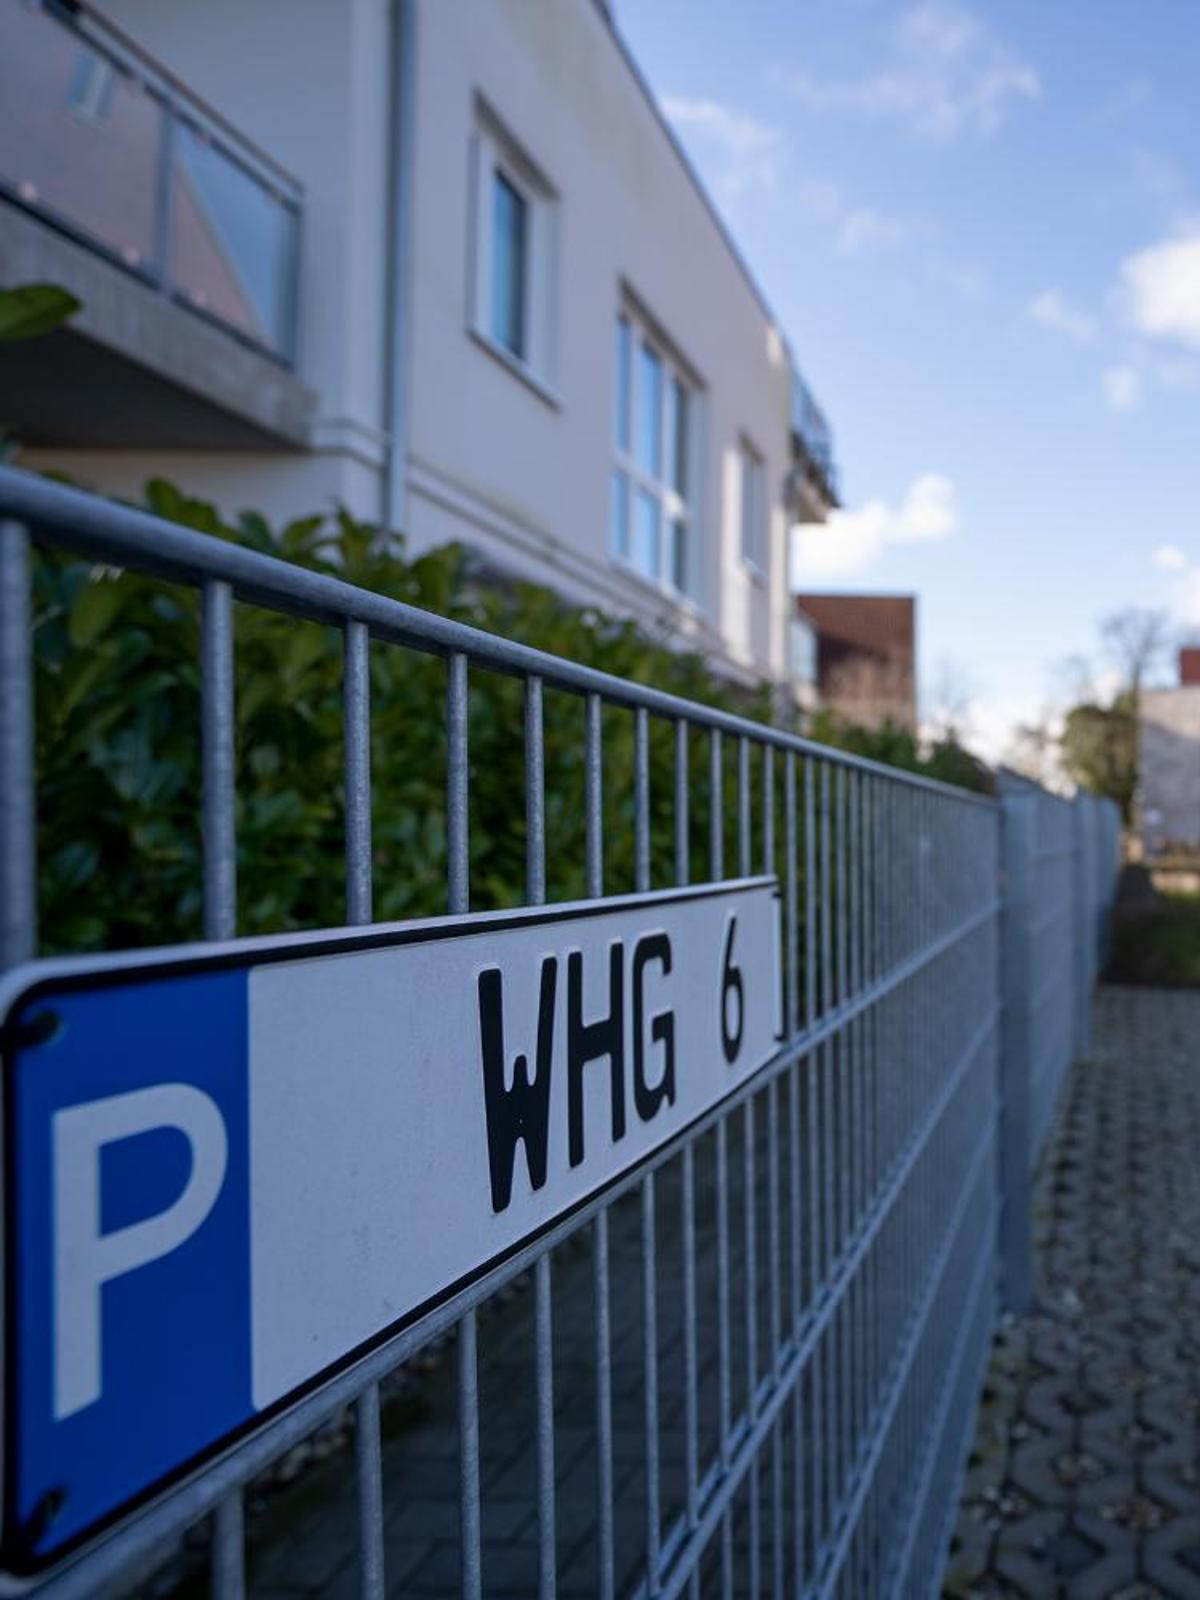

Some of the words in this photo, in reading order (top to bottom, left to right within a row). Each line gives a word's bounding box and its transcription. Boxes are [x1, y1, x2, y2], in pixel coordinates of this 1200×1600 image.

[478, 932, 676, 1214] WHG
[721, 914, 744, 1065] 6
[52, 1082, 229, 1423] P
